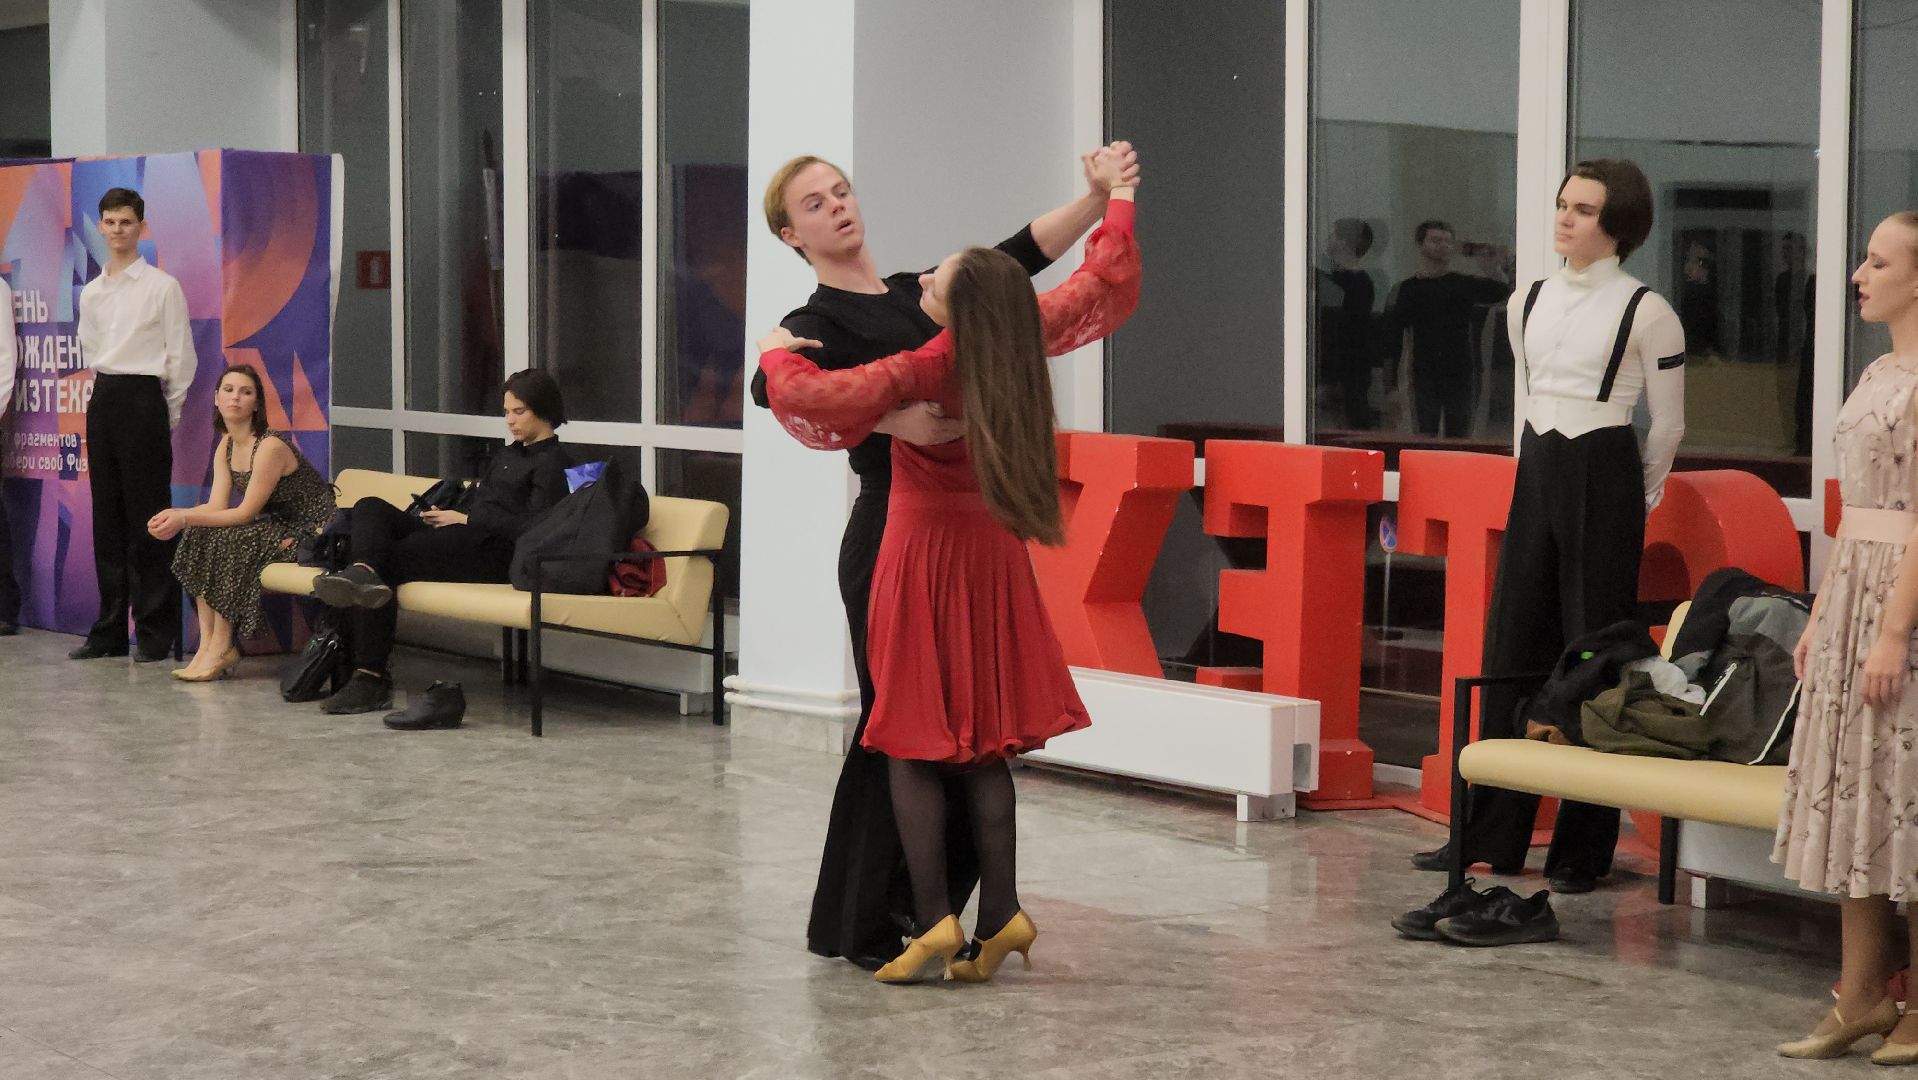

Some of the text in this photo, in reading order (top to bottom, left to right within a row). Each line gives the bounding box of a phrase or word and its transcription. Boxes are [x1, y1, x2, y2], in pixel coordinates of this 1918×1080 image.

[13, 290, 49, 323] ЕНЬ
[16, 379, 94, 414] ИЗТЕХА
[14, 433, 77, 449] фрагментов
[39, 454, 63, 471] свой
[67, 453, 89, 472] Физ
